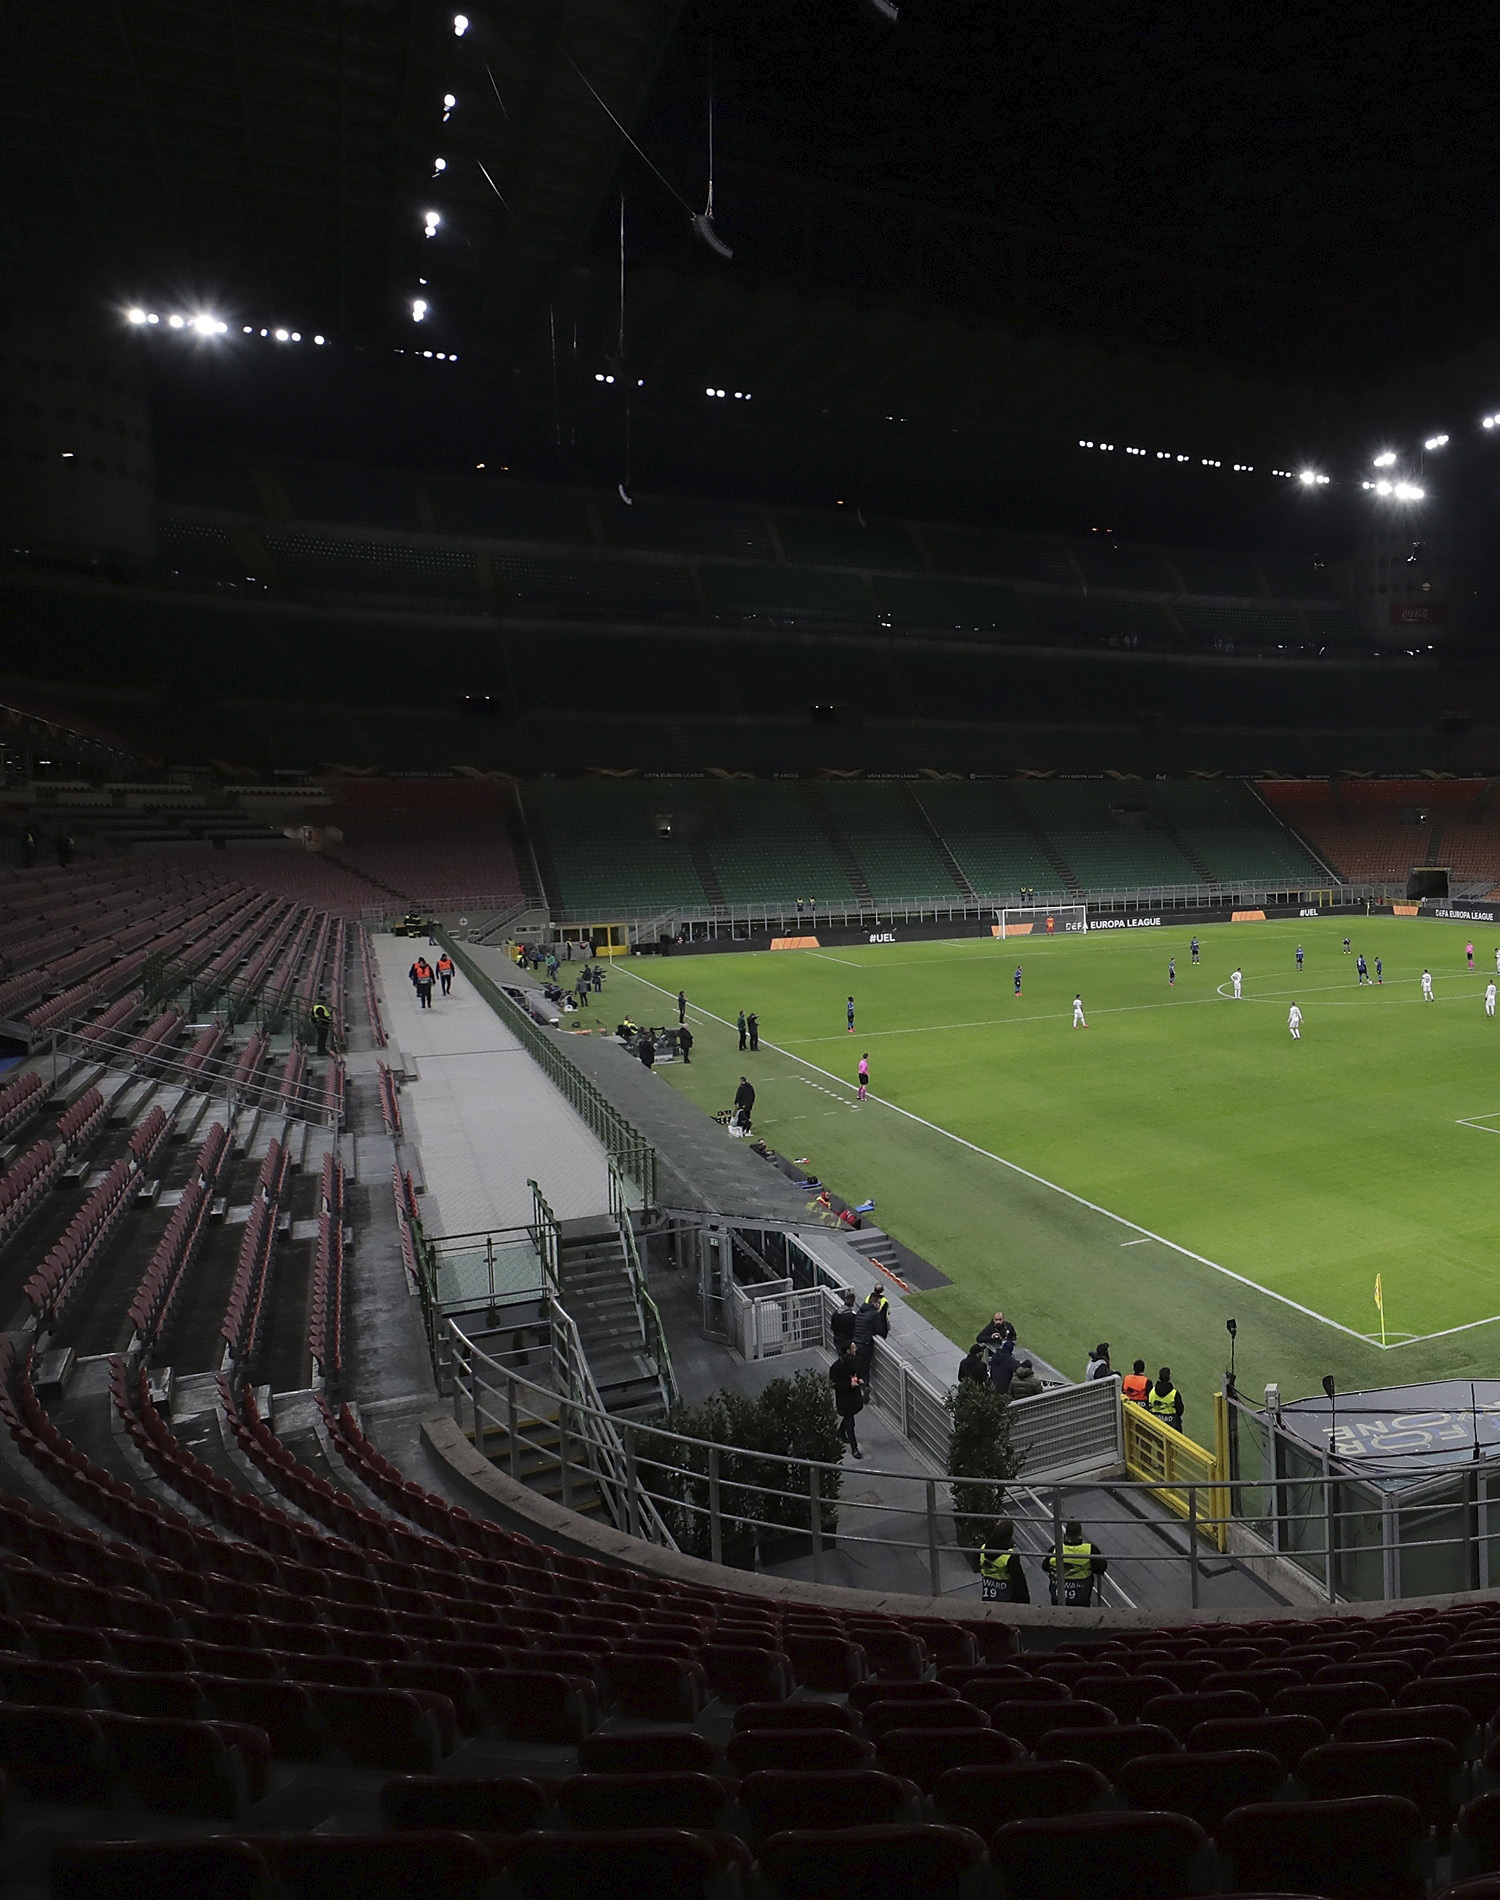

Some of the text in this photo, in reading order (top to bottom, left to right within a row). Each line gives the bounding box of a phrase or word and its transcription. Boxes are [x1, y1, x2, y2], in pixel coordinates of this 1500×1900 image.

[1300, 908, 1318, 917] #UEL
[1449, 910, 1471, 919] EUROPA
[1471, 912, 1494, 921] LEAGUE
[1090, 919, 1126, 929] EUROPA
[1127, 918, 1161, 926] LEAGUE
[869, 932, 895, 942] #UEL
